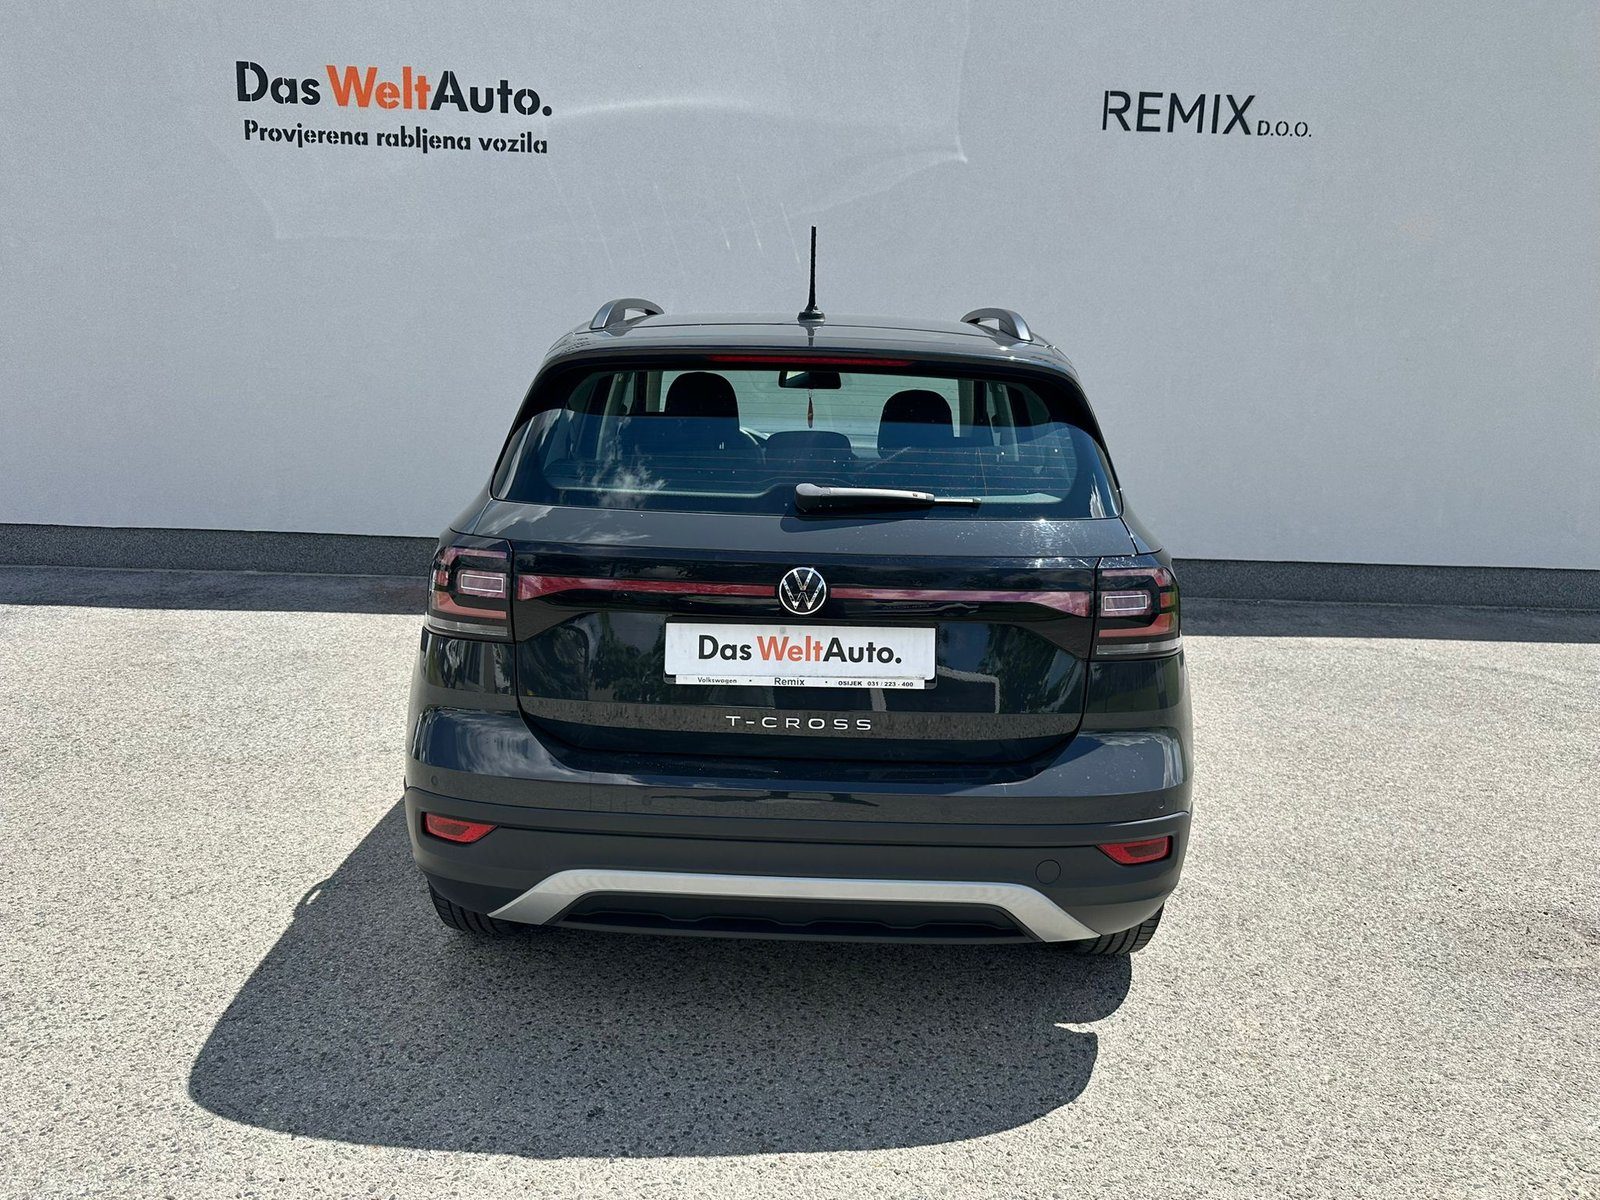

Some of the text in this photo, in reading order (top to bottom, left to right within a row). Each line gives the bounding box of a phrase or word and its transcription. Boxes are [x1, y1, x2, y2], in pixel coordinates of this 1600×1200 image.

[236, 61, 553, 116] Das WeltAuto.
[1102, 90, 1312, 137] REMIX D.O.O.
[244, 120, 548, 153] Provjerena rabljena vozila
[699, 635, 902, 664] Das WeltAuto.
[774, 677, 805, 686] Remix
[725, 715, 872, 731] T-CROSS
